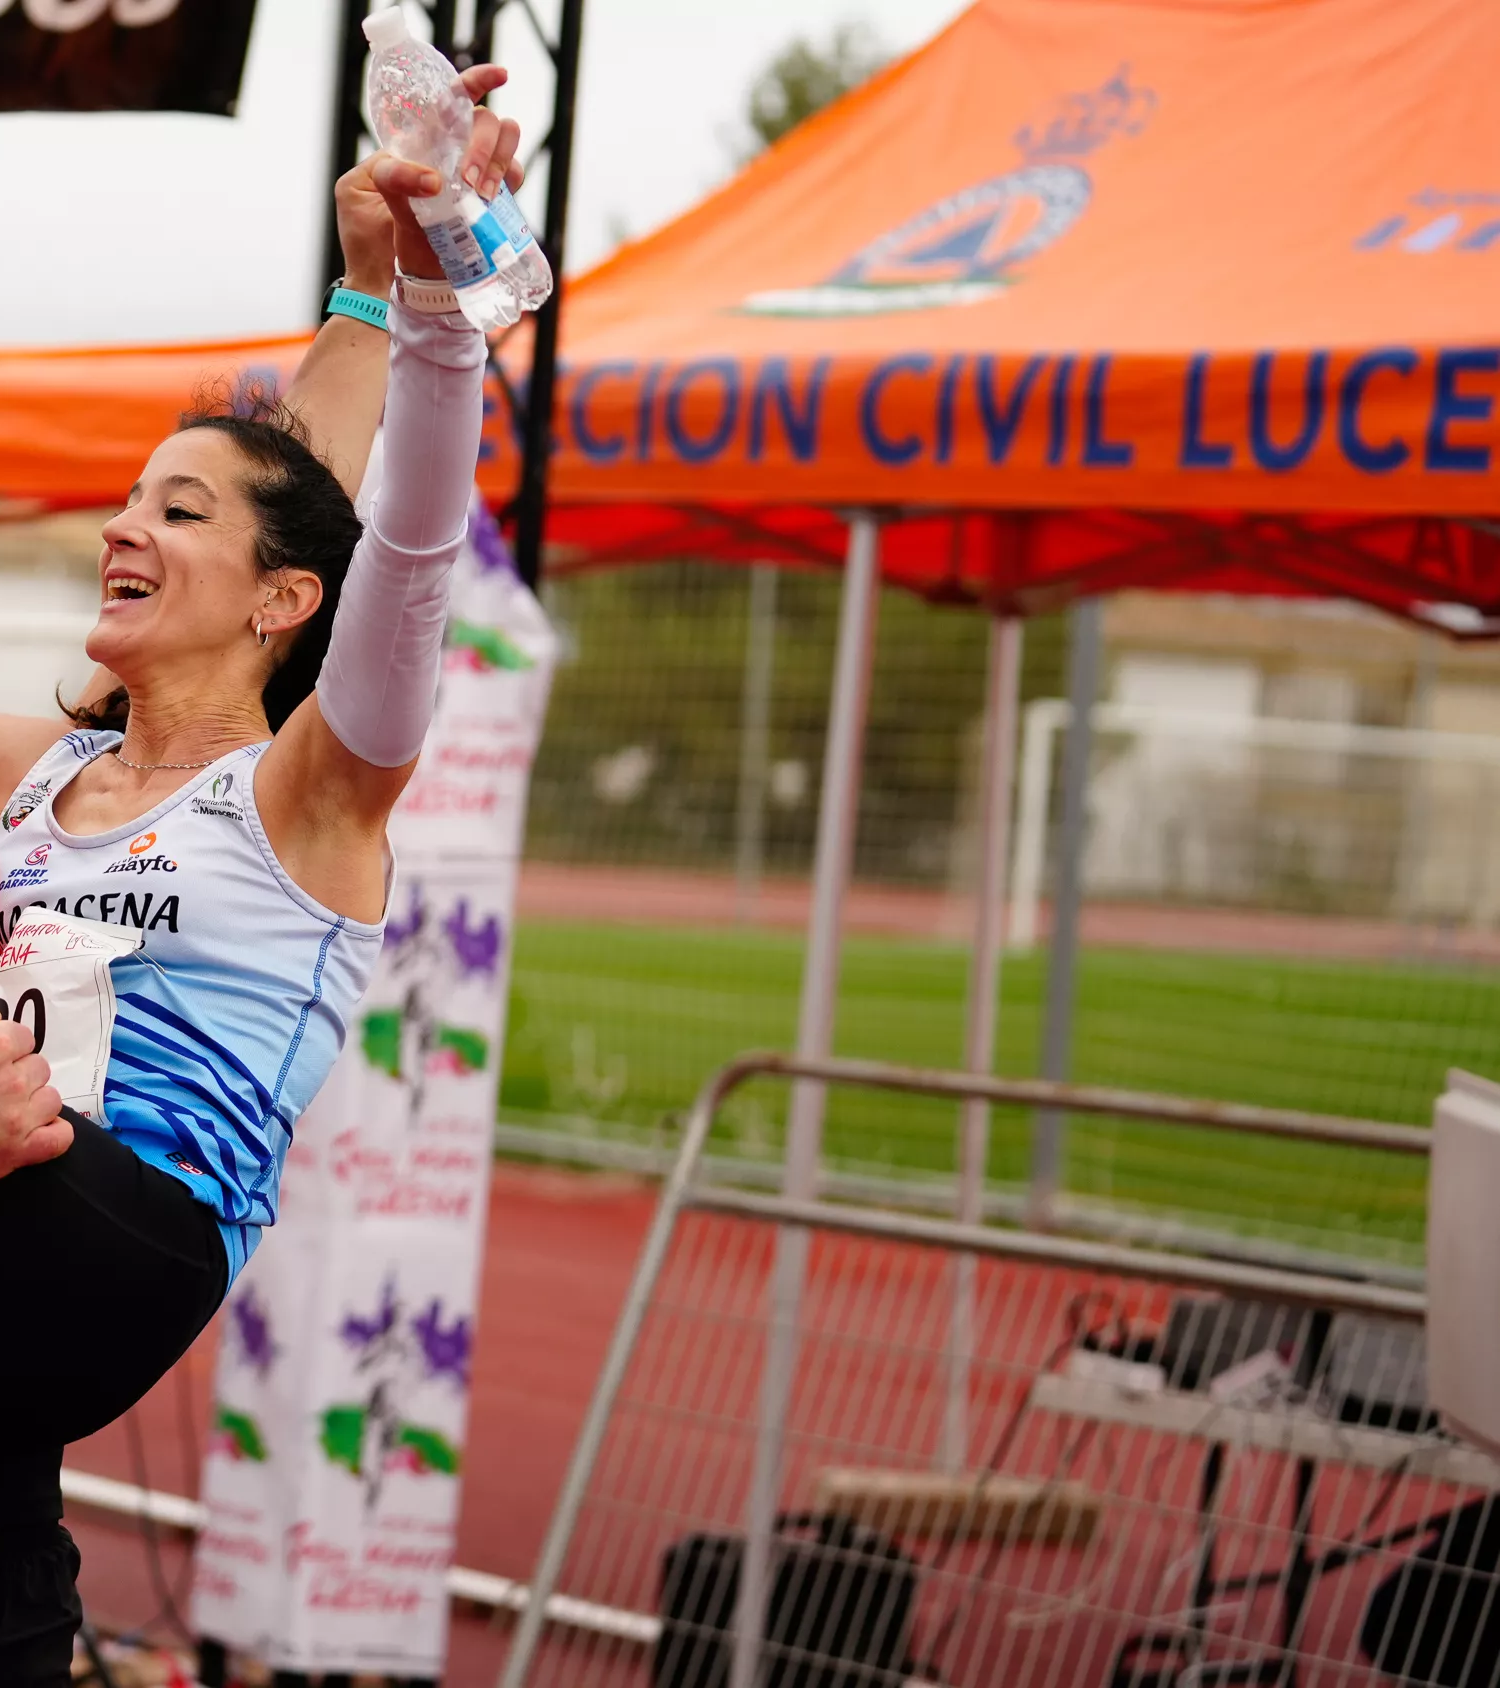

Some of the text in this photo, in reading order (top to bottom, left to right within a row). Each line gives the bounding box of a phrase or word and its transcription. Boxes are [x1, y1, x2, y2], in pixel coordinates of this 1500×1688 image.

[857, 352, 1135, 467] CIVIL
[1178, 345, 1500, 473] LUCE
[200, 806, 244, 821] Maracena
[7, 868, 49, 879] SPORT
[103, 855, 179, 875] mayfo
